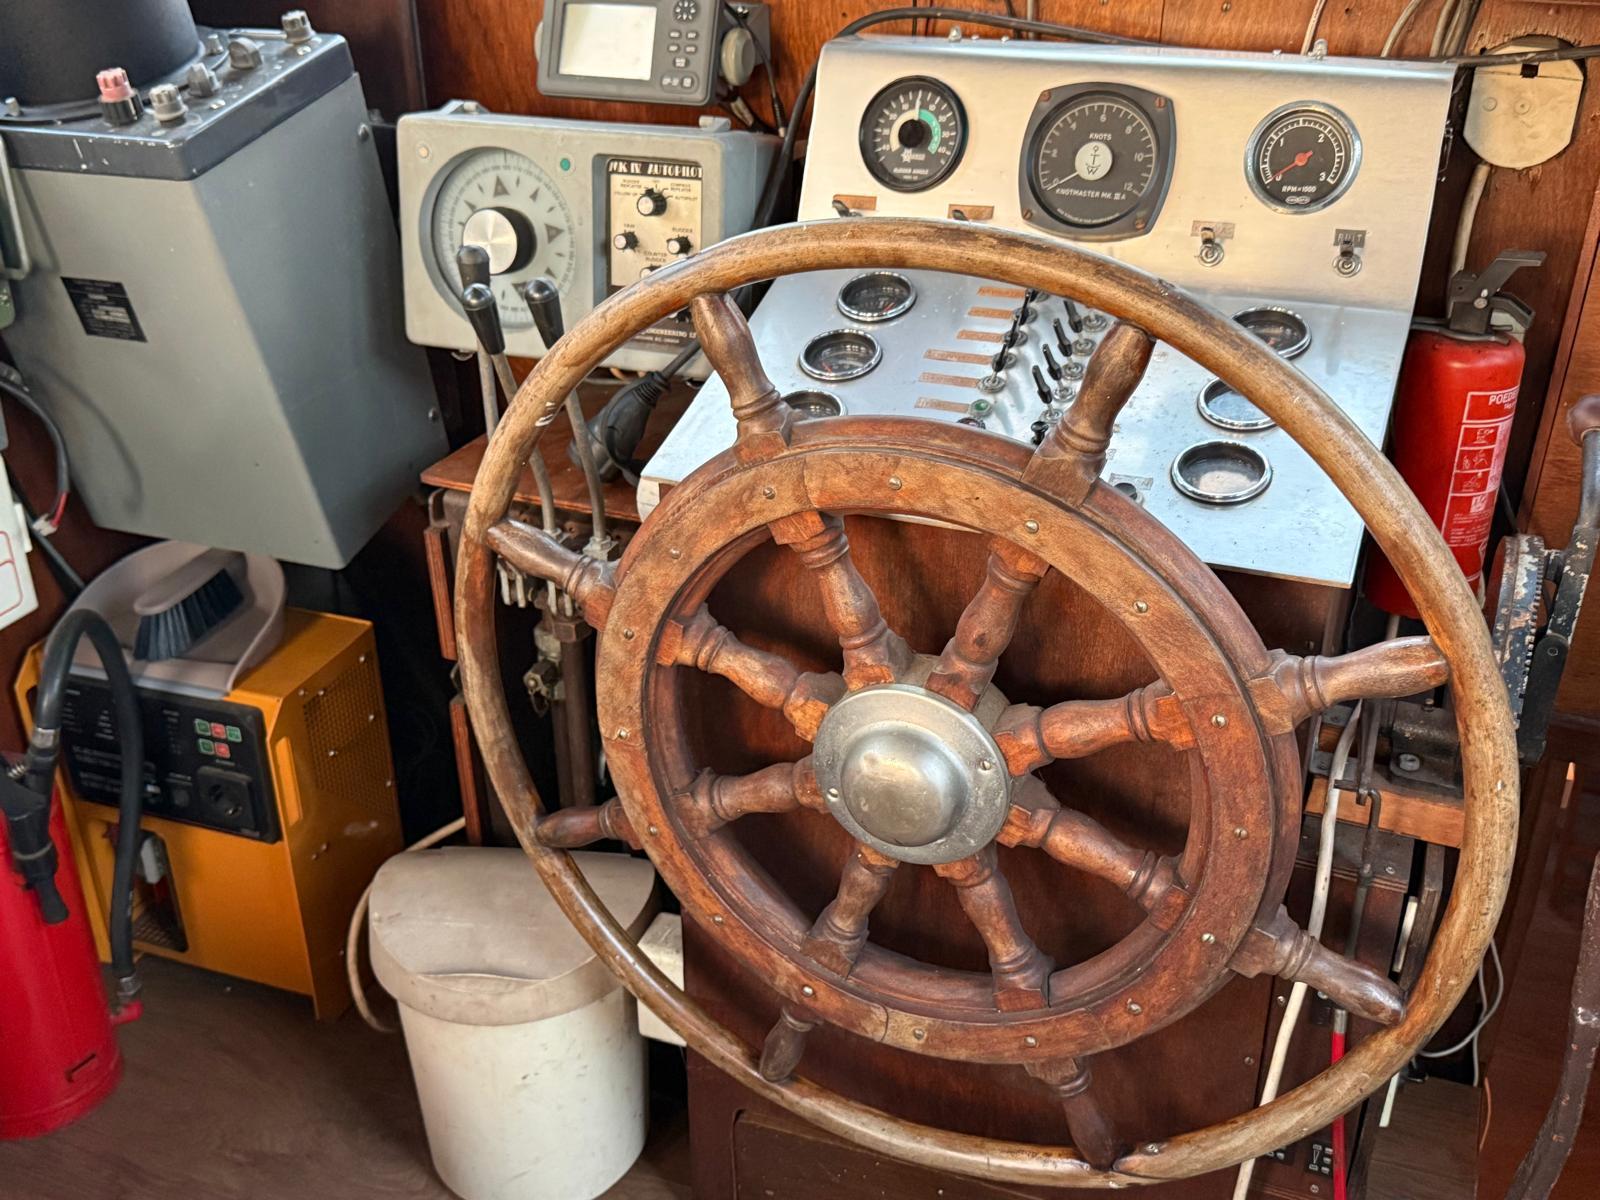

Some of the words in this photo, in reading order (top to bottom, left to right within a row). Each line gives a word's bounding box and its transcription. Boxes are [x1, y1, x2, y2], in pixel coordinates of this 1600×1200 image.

[1100, 114, 1107, 122] 6
[1069, 122, 1077, 131] 4
[1125, 126, 1132, 134] 8
[1089, 133, 1112, 141] KNOTS
[1317, 133, 1325, 143] 2
[1279, 138, 1284, 147] 1
[1051, 149, 1058, 158] 2
[1134, 152, 1144, 162] 10
[647, 163, 703, 178] AUTOPILOT
[1319, 172, 1326, 182] 3
[1124, 182, 1133, 192] 12
[1055, 188, 1100, 199] KNOTMASTER
